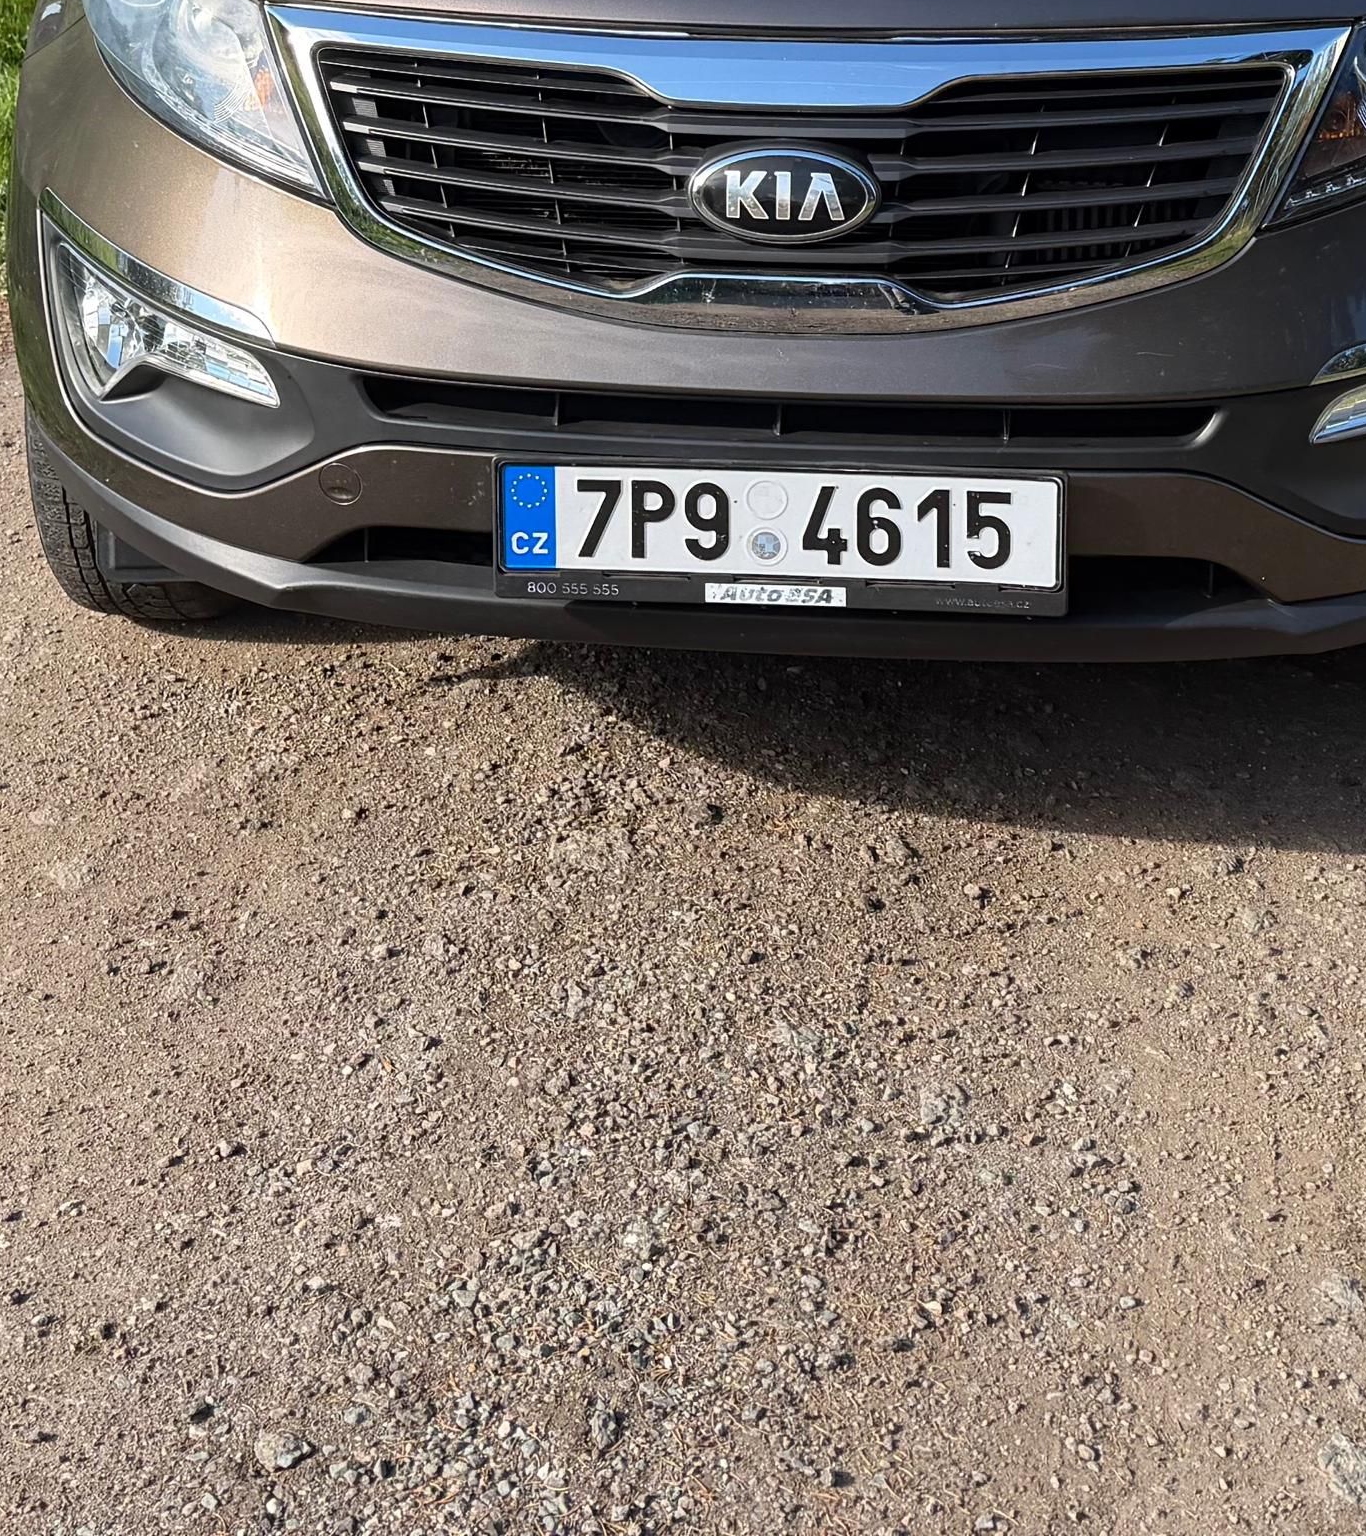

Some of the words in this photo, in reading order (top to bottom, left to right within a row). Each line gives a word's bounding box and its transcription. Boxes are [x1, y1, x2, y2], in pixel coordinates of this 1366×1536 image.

[724, 170, 845, 221] KIA
[511, 531, 549, 554] CZ
[576, 479, 730, 561] 7P9
[802, 485, 1012, 570] 4615
[527, 581, 557, 594] 800
[562, 582, 588, 595] 555
[592, 583, 620, 596] 555
